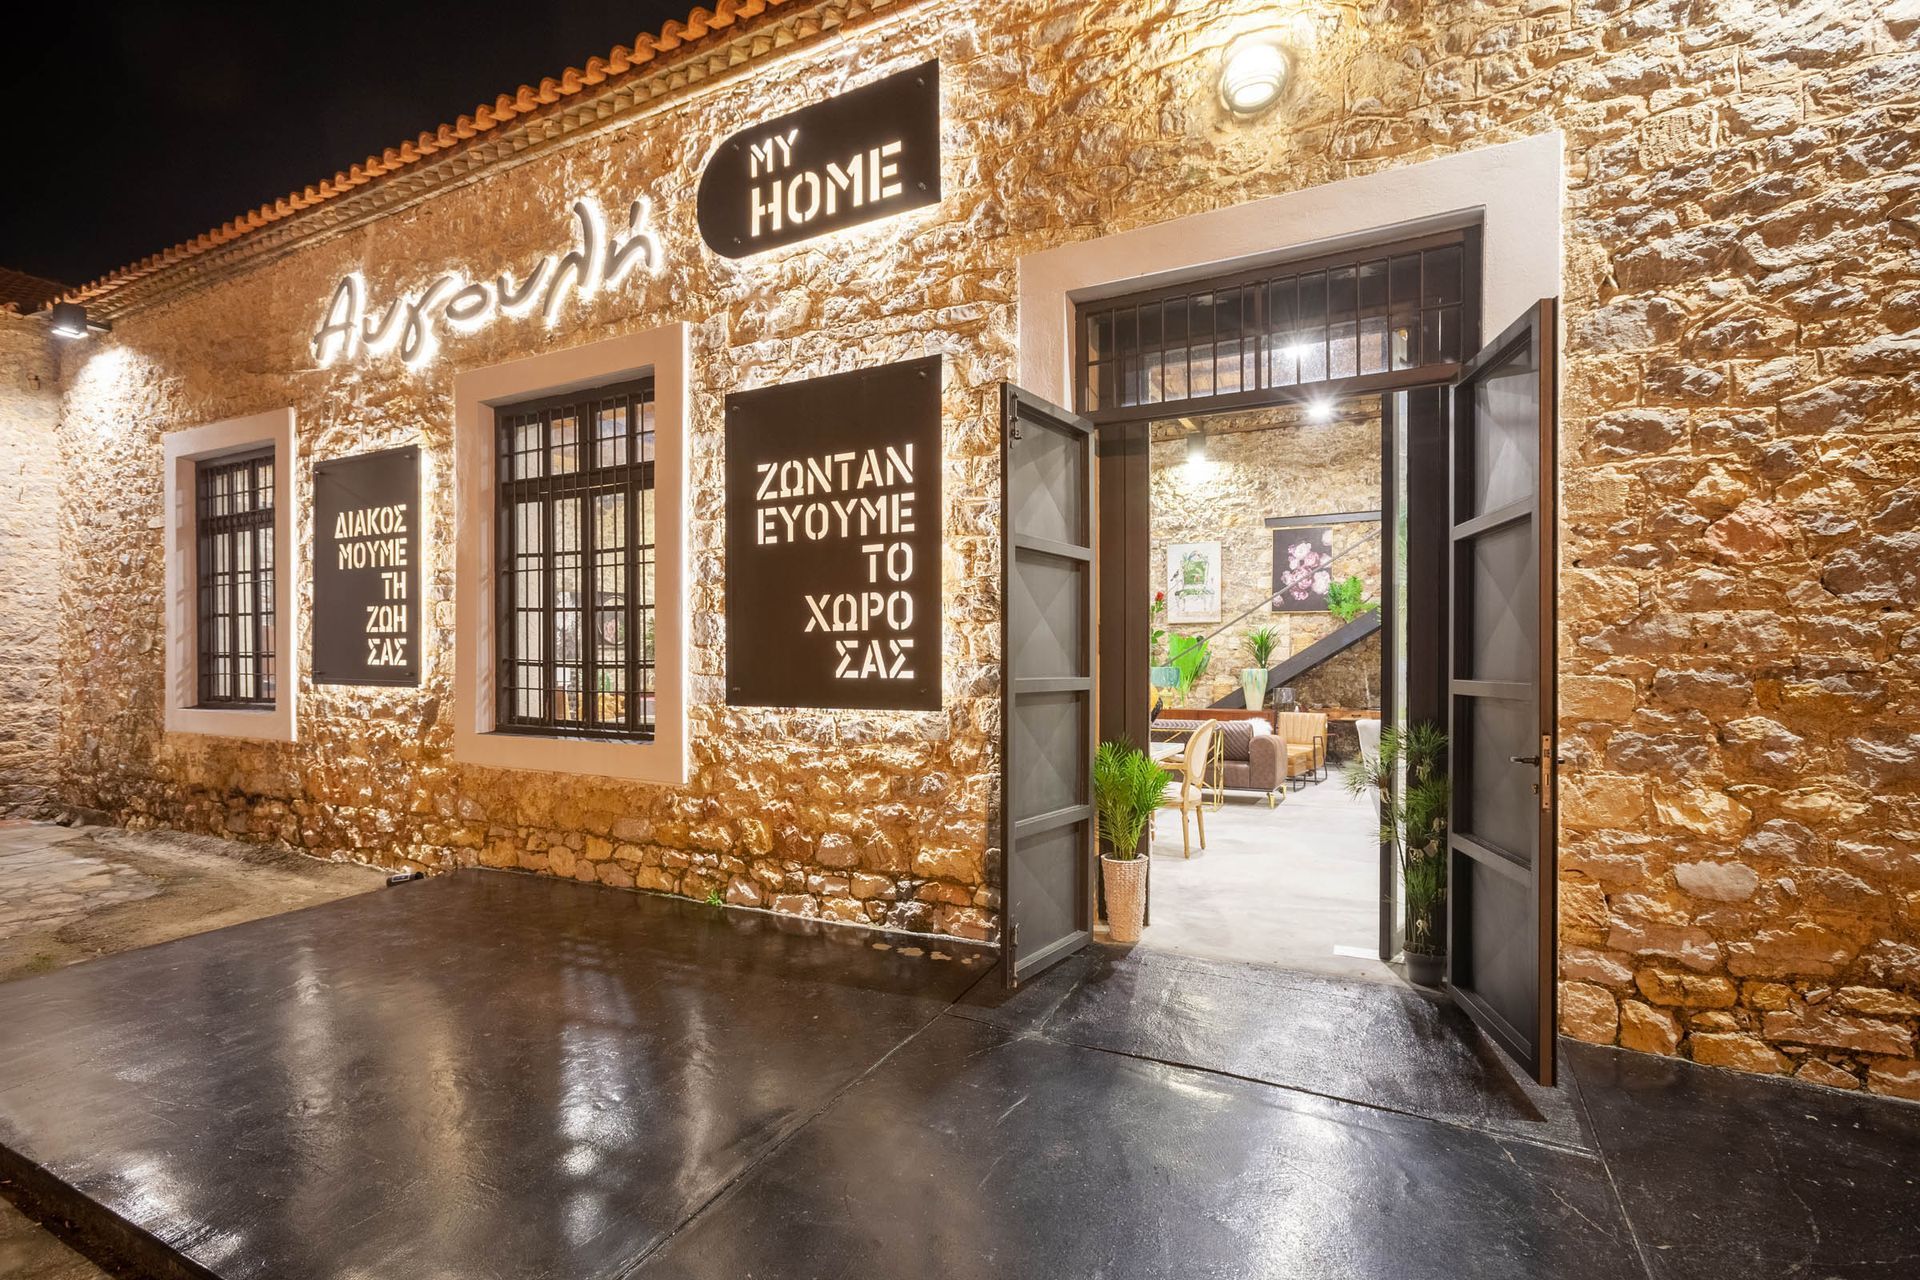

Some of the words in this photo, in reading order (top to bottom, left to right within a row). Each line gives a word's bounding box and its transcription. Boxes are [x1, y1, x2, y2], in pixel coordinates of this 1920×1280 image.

[751, 129, 799, 178] MY
[751, 141, 902, 237] HOME
[757, 443, 913, 500] ΖΩΝΤΑΝ
[334, 504, 407, 539] ΔΙΑΚΟΣ
[757, 492, 915, 545] ΕΥΟΥΜΕ
[338, 538, 407, 570] ΜΟΥΜΕ
[862, 542, 913, 583] ΤΟ
[381, 571, 407, 600] ΤΗ
[366, 604, 407, 633] ΖΩΗ
[804, 591, 913, 632] ΧΩΡΟ
[367, 638, 407, 666] ΣΑΣ
[836, 639, 914, 679] ΣΑΣ
